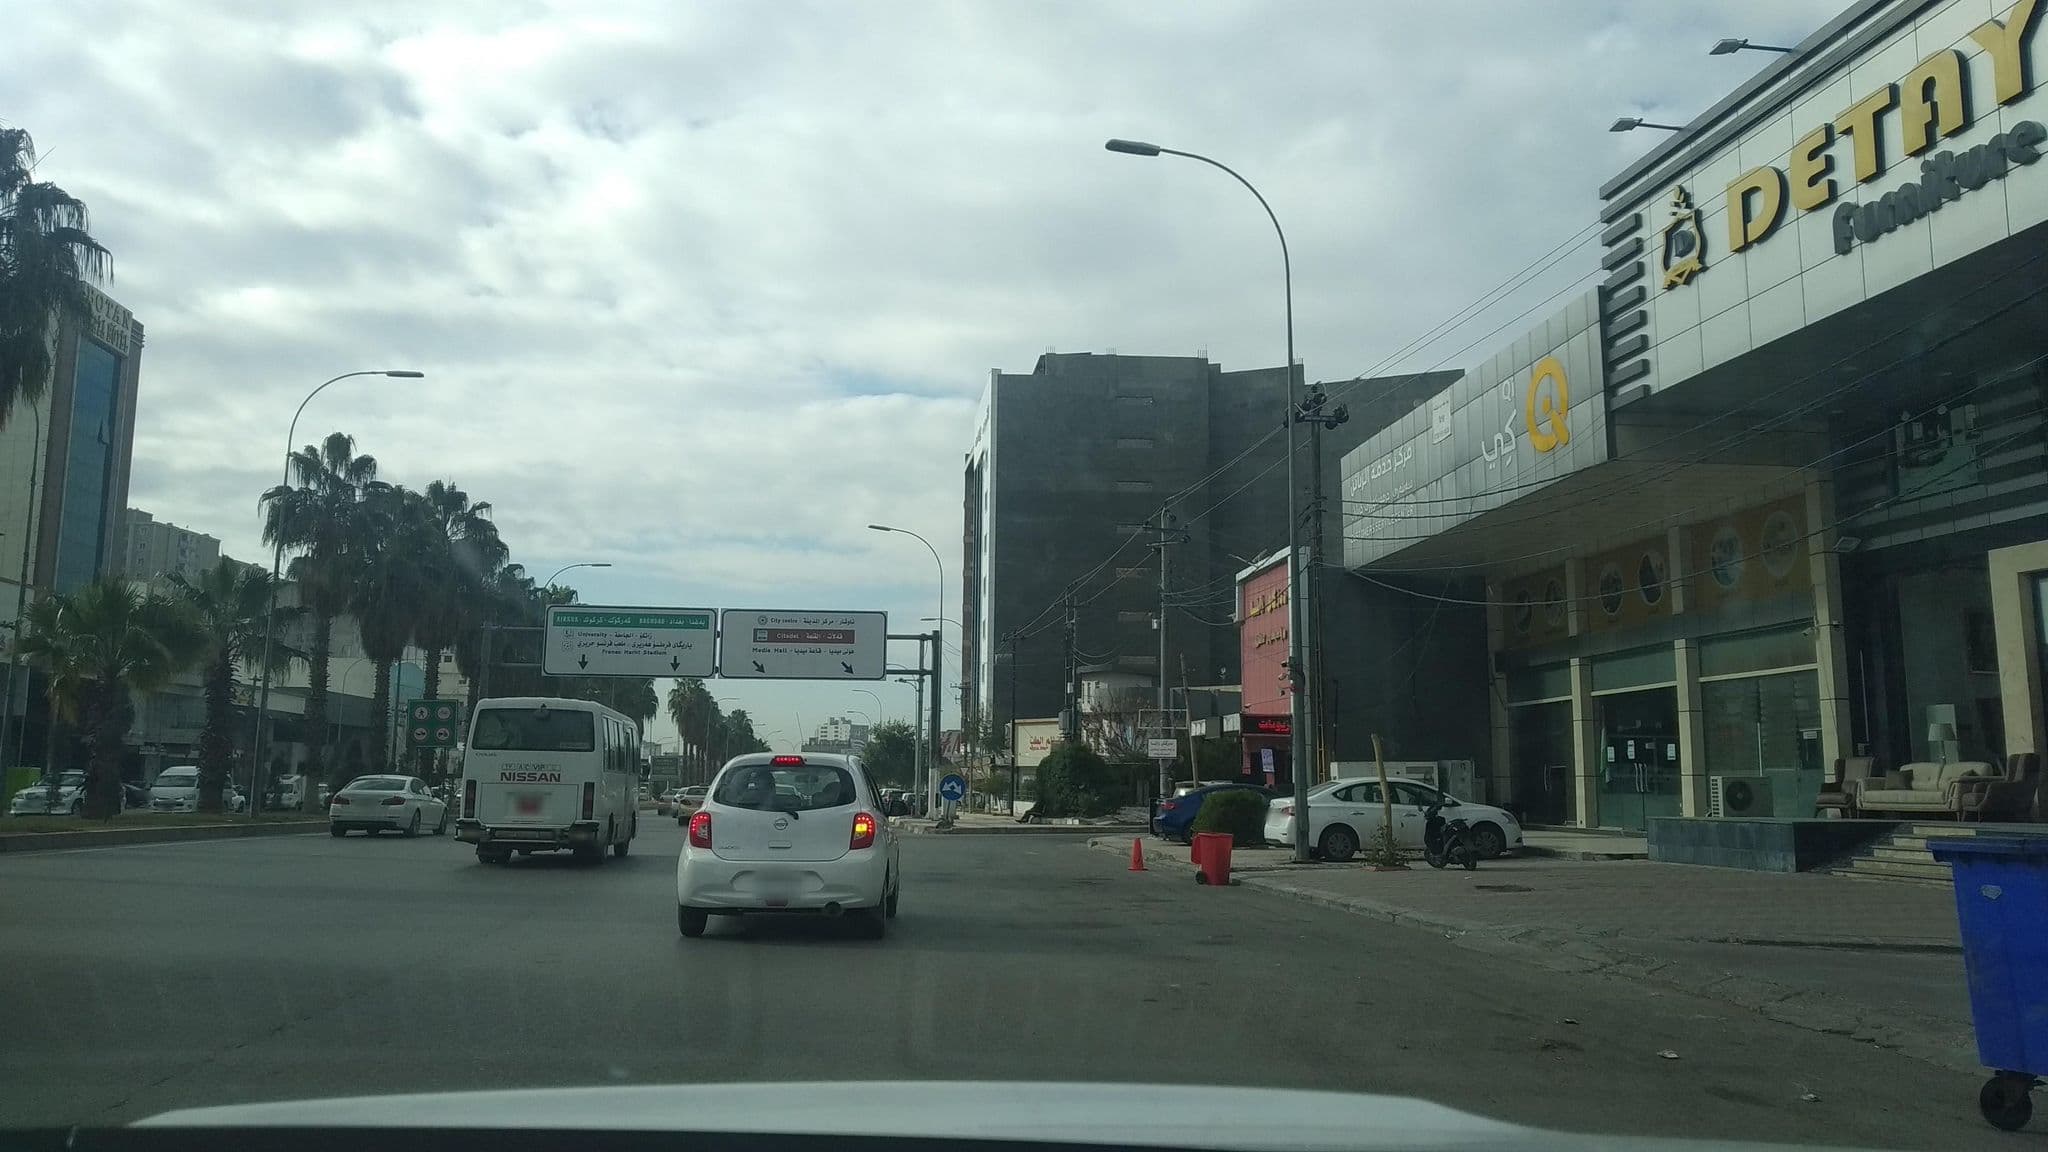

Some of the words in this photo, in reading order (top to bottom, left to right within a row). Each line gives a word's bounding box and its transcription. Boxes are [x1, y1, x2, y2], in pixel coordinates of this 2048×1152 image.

[1727, 0, 2040, 252] DETAY
[1393, 445, 1413, 473] مركز
[770, 617, 781, 625] City
[577, 631, 608, 639] University
[776, 632, 799, 640] Citadel
[500, 771, 561, 783] NISSAN
